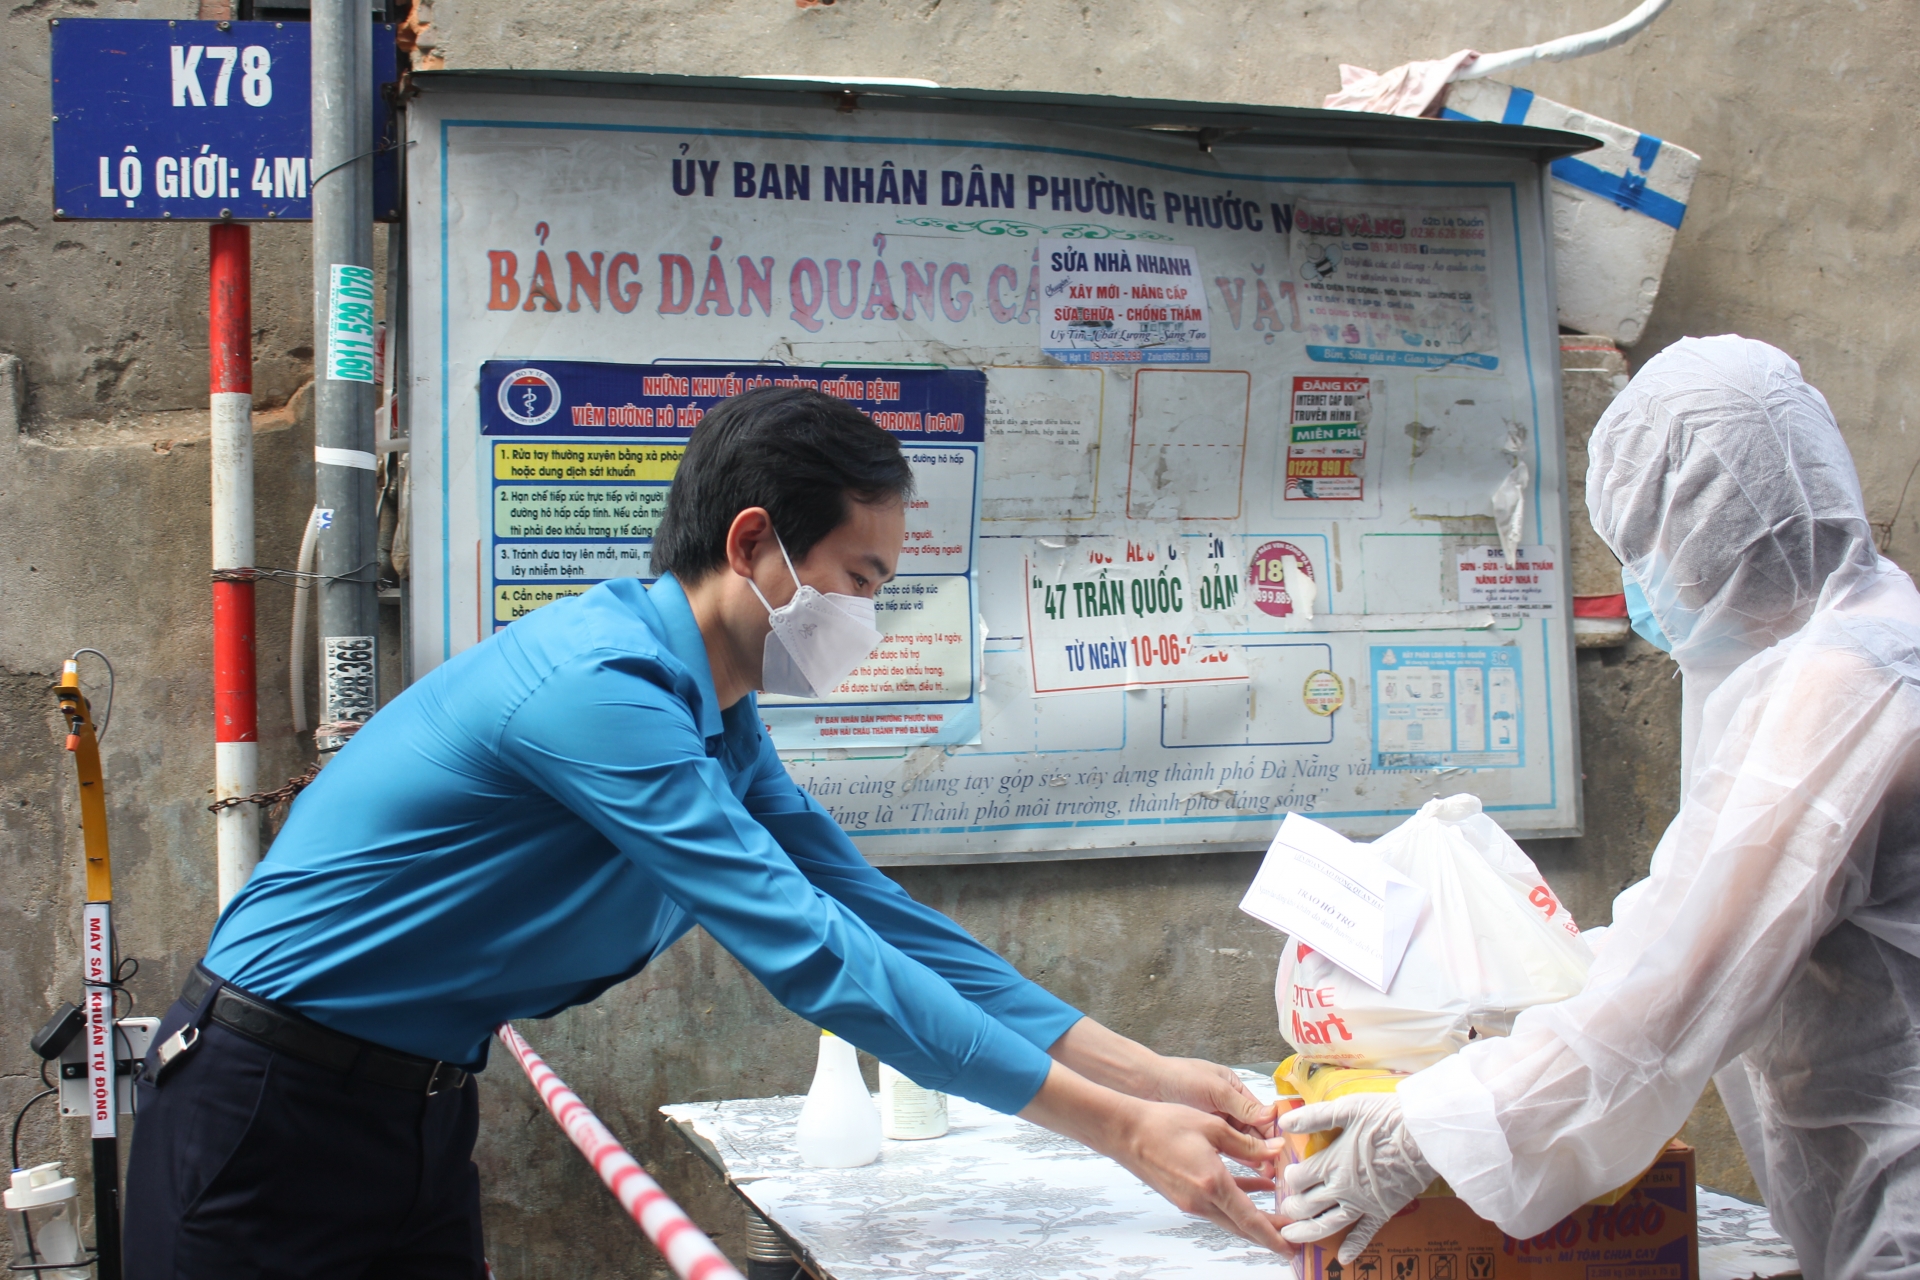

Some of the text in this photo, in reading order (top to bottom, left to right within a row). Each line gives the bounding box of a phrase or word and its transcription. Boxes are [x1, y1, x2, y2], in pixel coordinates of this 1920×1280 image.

[170, 46, 272, 107] K78
[100, 145, 142, 208] LỘ
[156, 144, 239, 198] GIỚI:
[671, 142, 1263, 232] ỦY BAN NHÂN DÂN PHƯỜNG PHƯỚC
[1051, 246, 1192, 276] SỬA NHÀ NHANH
[486, 221, 643, 314] BẢNG
[658, 236, 775, 316] DÁN
[789, 232, 974, 333] QUẢNG
[1069, 284, 1188, 300] XÂY MỚI NÂNG CẤP
[1082, 305, 1115, 321] CHỮA
[1126, 304, 1167, 321] CHỐNG
[643, 372, 689, 397] NHỮNG
[691, 372, 743, 398] KHUYẾN
[820, 374, 864, 400] CHỐNG
[866, 377, 900, 404] BỆNH
[1302, 380, 1341, 391] ĐĂNG
[1296, 394, 1328, 406] INTERNET
[571, 402, 606, 427] VIÊM
[608, 403, 654, 427] ĐƯỜNG
[656, 404, 674, 427] HÔ
[677, 402, 704, 427] HẤP
[875, 411, 922, 432] CORONA
[924, 413, 965, 434] (nCoV)
[1295, 407, 1351, 421] TRUYỀN HÌNH
[512, 448, 643, 463] Rửa tay thường xuyên bằng
[511, 465, 636, 479] hoặc dung dịch sát khuẩn
[1288, 460, 1341, 476] 01223 990
[511, 490, 664, 504] Hạn chế xúc người
[510, 507, 591, 520] đường hấp cấp
[523, 524, 653, 539] phải khẩu trang đúng
[512, 549, 577, 562] Tránh đưa tay
[511, 562, 558, 578] lây nhiễm
[512, 588, 533, 601] Cần
[535, 590, 553, 601] che
[1072, 568, 1126, 618] TRẦN
[1131, 564, 1183, 618] QUỐC
[1065, 639, 1085, 671] TỪ
[1088, 636, 1128, 670] NGÀY
[848, 774, 896, 799] cùng
[963, 776, 995, 796] tay
[999, 767, 1034, 794] góp
[1074, 767, 1108, 787] xây
[1113, 761, 1159, 788] dựng
[1163, 760, 1213, 784] thành
[1218, 756, 1255, 789] phố
[1259, 760, 1289, 780] Đà
[1294, 753, 1340, 782] Nẵng
[874, 805, 894, 824] là
[900, 801, 970, 825] “Thành
[973, 793, 1011, 825] phố
[1015, 797, 1052, 817] môi
[1055, 796, 1122, 819] trường,
[1128, 789, 1181, 813] thành
[1224, 789, 1270, 813] đáng
[1296, 888, 1320, 906] TRAO
[1336, 911, 1357, 929] TRỢ
[90, 917, 102, 952] MÁY
[91, 991, 109, 1047] KHUẨN
[92, 1051, 107, 1073] TỰ
[92, 1075, 108, 1121] ĐỘNG
[1652, 1173, 1673, 1183] BẢN
[1588, 1188, 1666, 1243] Hảo
[1576, 1250, 1599, 1261] TÔM
[1603, 1250, 1632, 1260] CHUA
[1634, 1249, 1658, 1260] CAY
